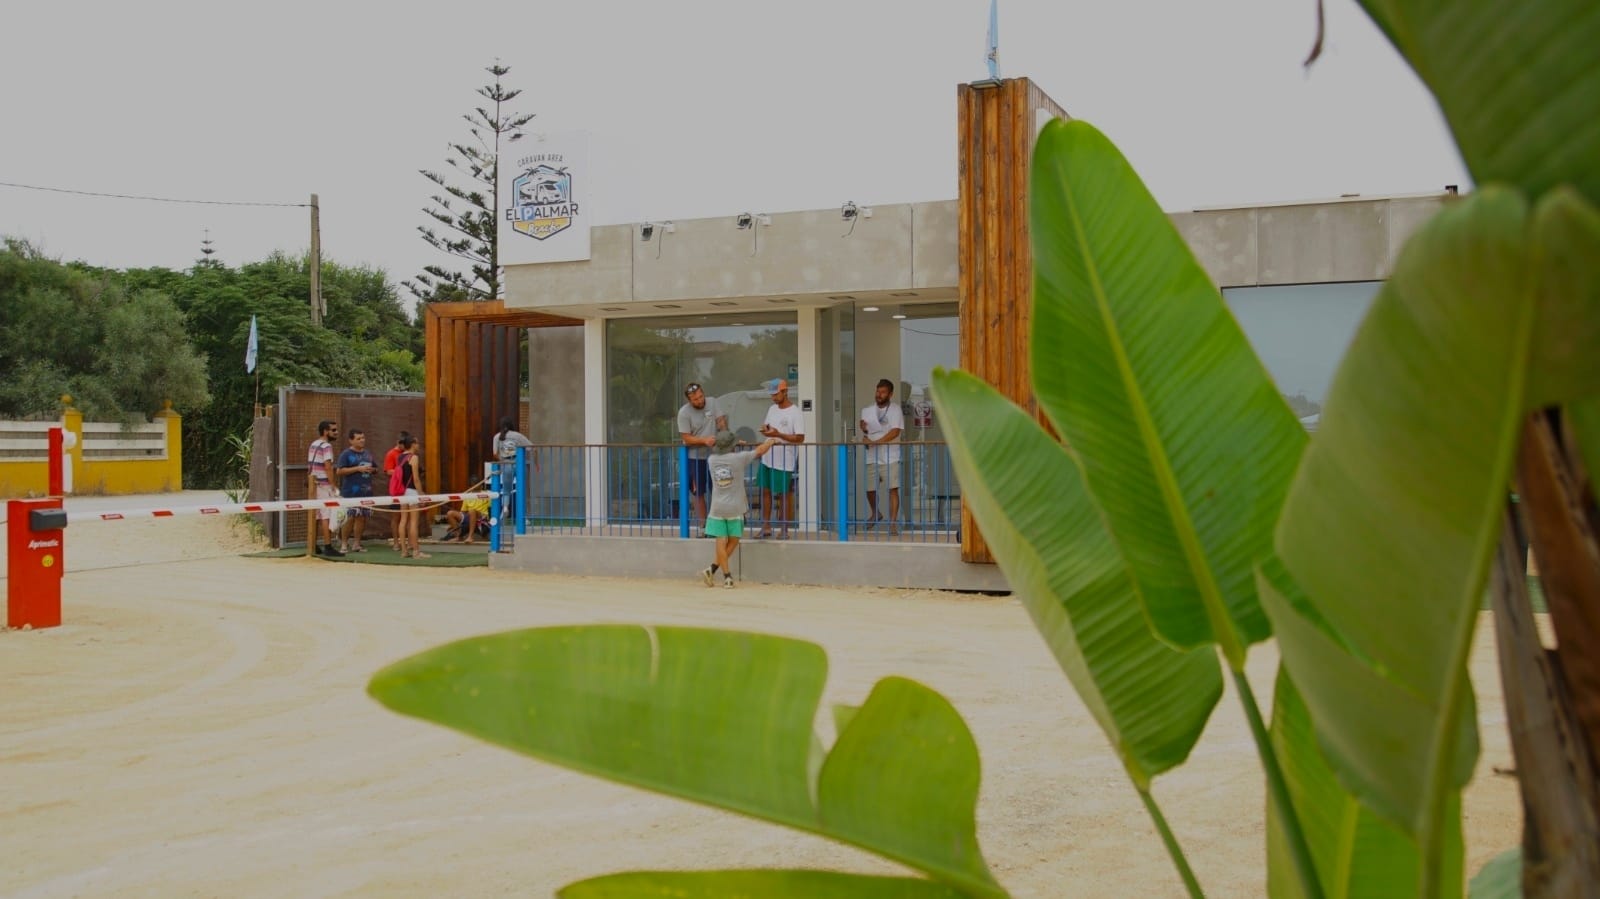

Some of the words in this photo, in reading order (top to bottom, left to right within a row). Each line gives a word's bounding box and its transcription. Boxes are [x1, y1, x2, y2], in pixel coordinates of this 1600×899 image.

[517, 153, 545, 167] CARAVAN
[547, 153, 563, 161] AREA
[506, 208, 520, 221] EL
[523, 203, 579, 220] PALMAR
[28, 539, 59, 549] Aprimatic
